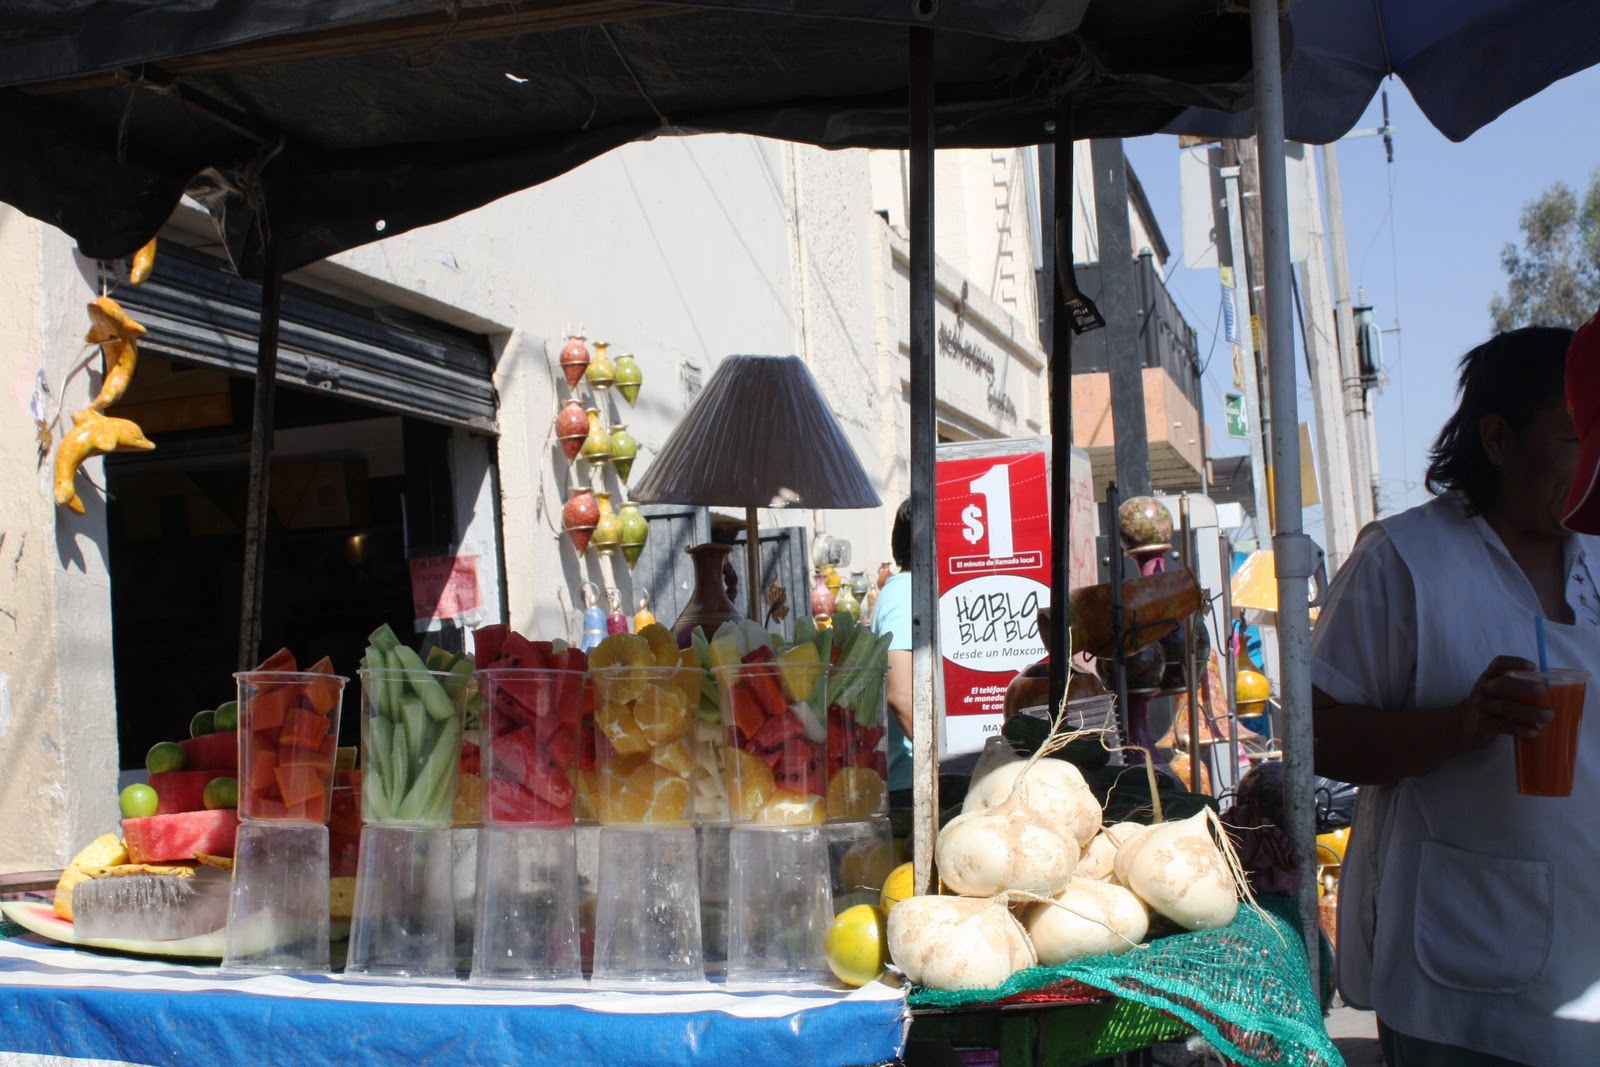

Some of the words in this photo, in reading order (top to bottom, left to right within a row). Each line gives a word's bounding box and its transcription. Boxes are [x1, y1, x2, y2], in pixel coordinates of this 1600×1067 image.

[963, 560, 985, 568] minuto
[995, 557, 1019, 566] llamada
[1020, 556, 1035, 564] local
[952, 649, 983, 660] desde
[986, 649, 999, 658] un
[1002, 646, 1047, 657] Maxcom
[971, 687, 978, 695] El
[963, 695, 973, 703] de
